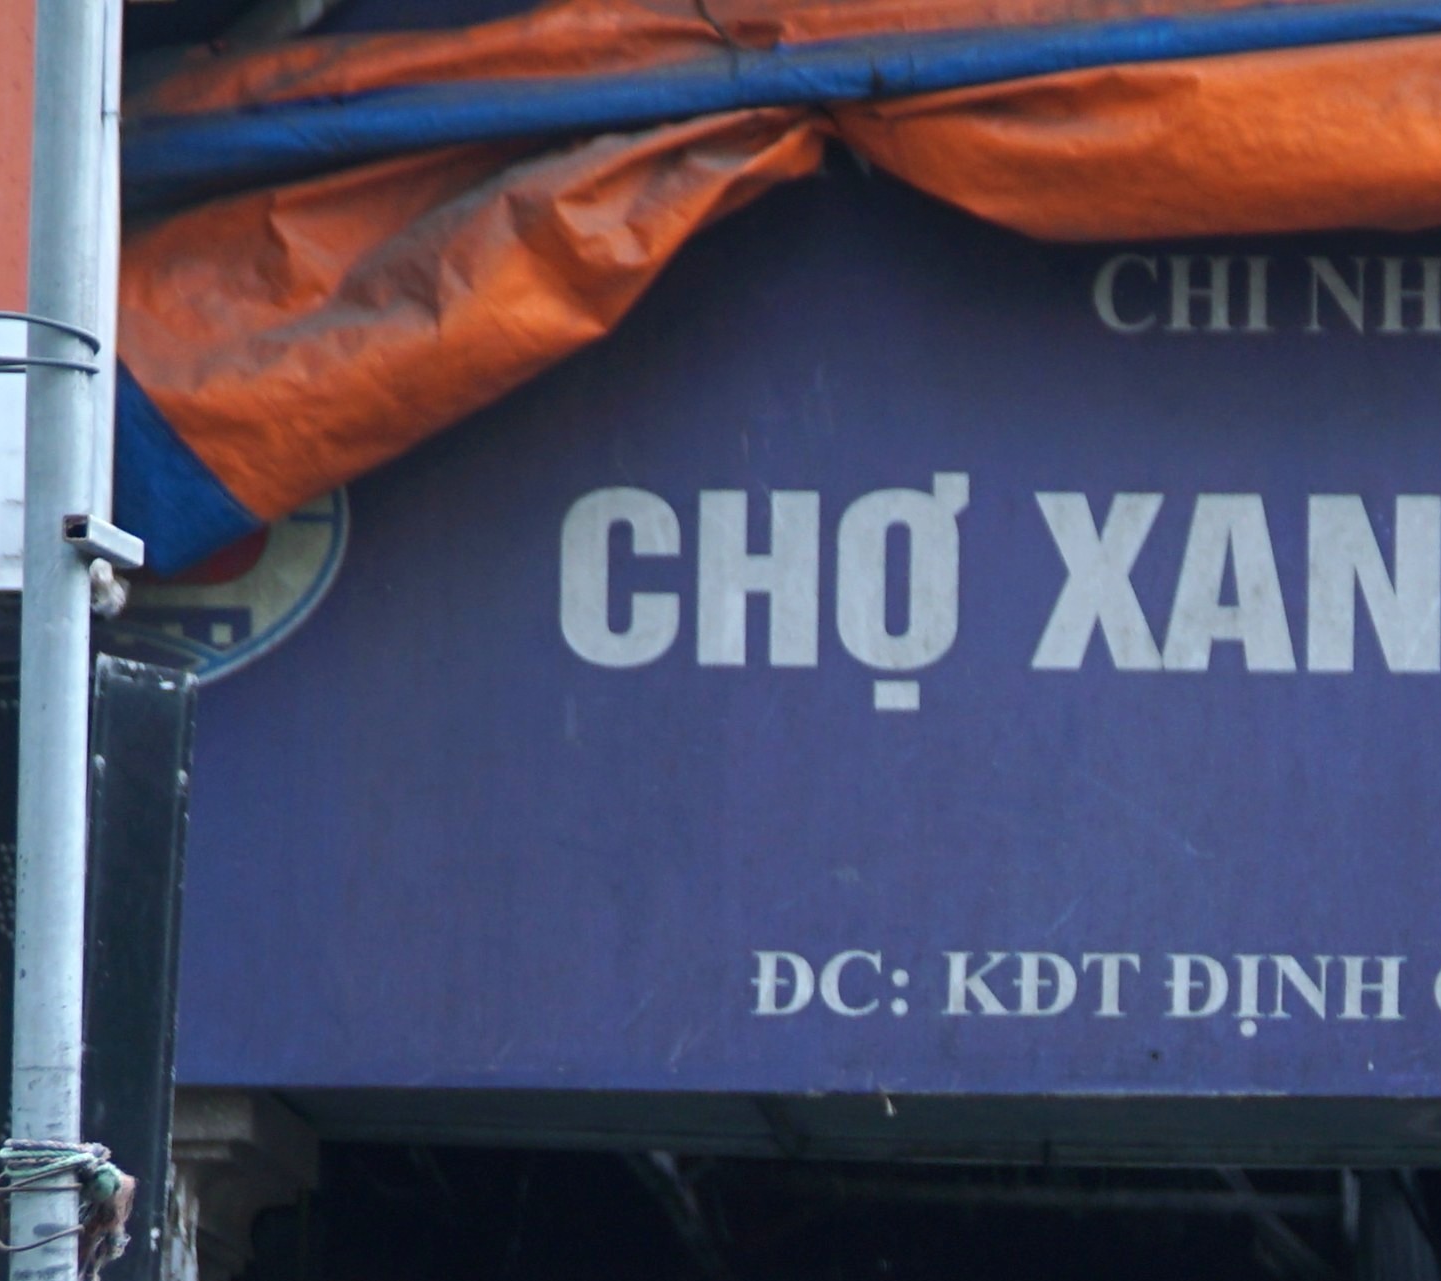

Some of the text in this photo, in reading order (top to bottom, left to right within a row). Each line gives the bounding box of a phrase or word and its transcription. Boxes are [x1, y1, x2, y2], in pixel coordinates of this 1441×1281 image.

[1093, 254, 1270, 333] CHI
[561, 472, 970, 711] CHỢ
[749, 948, 911, 1018] ĐC:
[940, 950, 1143, 1019] KĐT
[1165, 951, 1405, 1041] ĐỊNH
